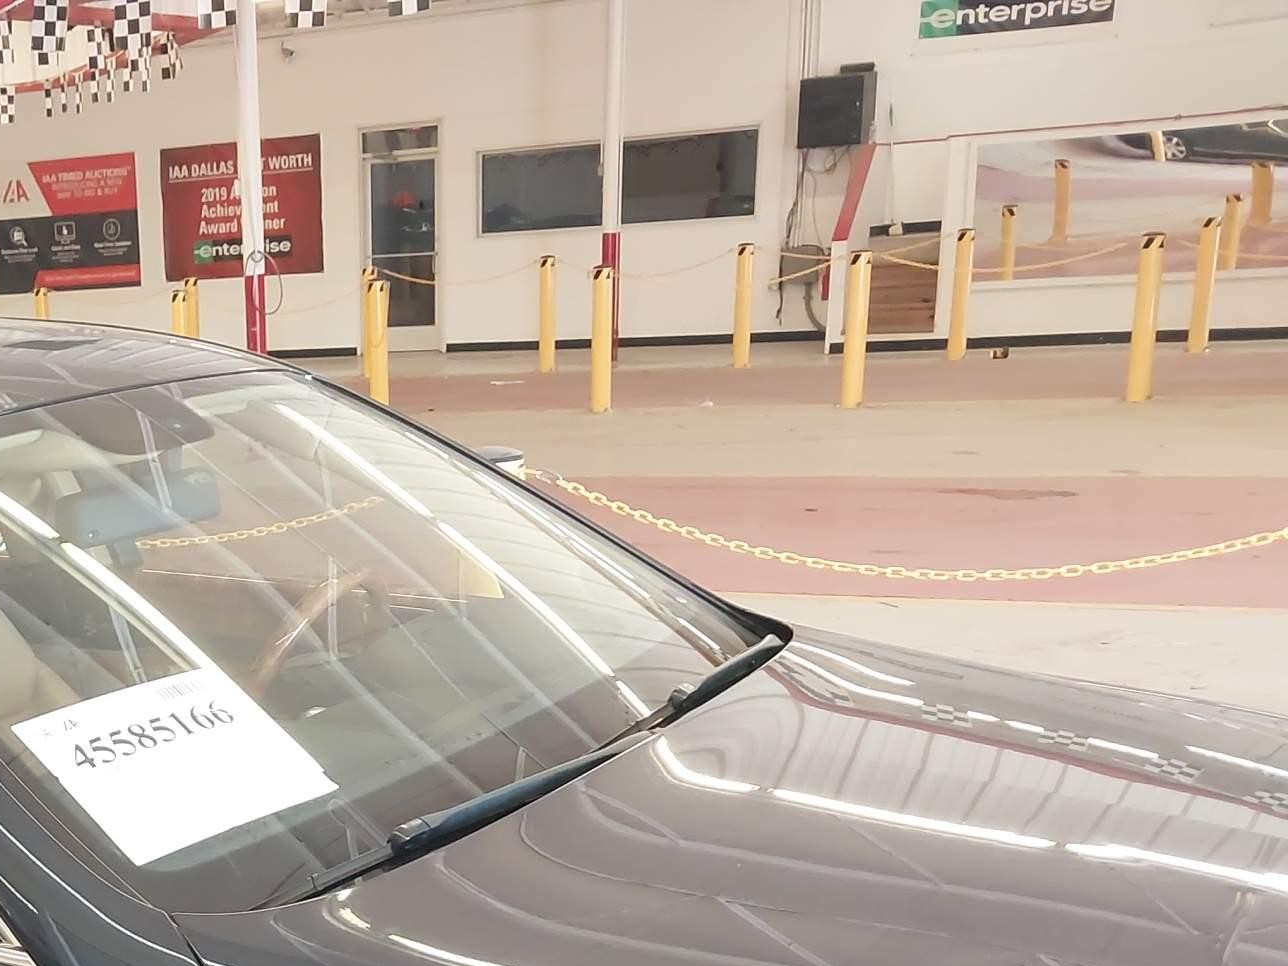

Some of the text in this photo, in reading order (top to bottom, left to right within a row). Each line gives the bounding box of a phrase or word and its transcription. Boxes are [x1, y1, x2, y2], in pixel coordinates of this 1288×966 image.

[920, 0, 1111, 29] enterprise
[168, 164, 189, 179] IAA
[192, 160, 234, 176] DALLAS
[268, 152, 312, 171] WORTH
[200, 186, 227, 203] 2019
[199, 219, 238, 236] Award
[73, 700, 235, 769] 45585166
